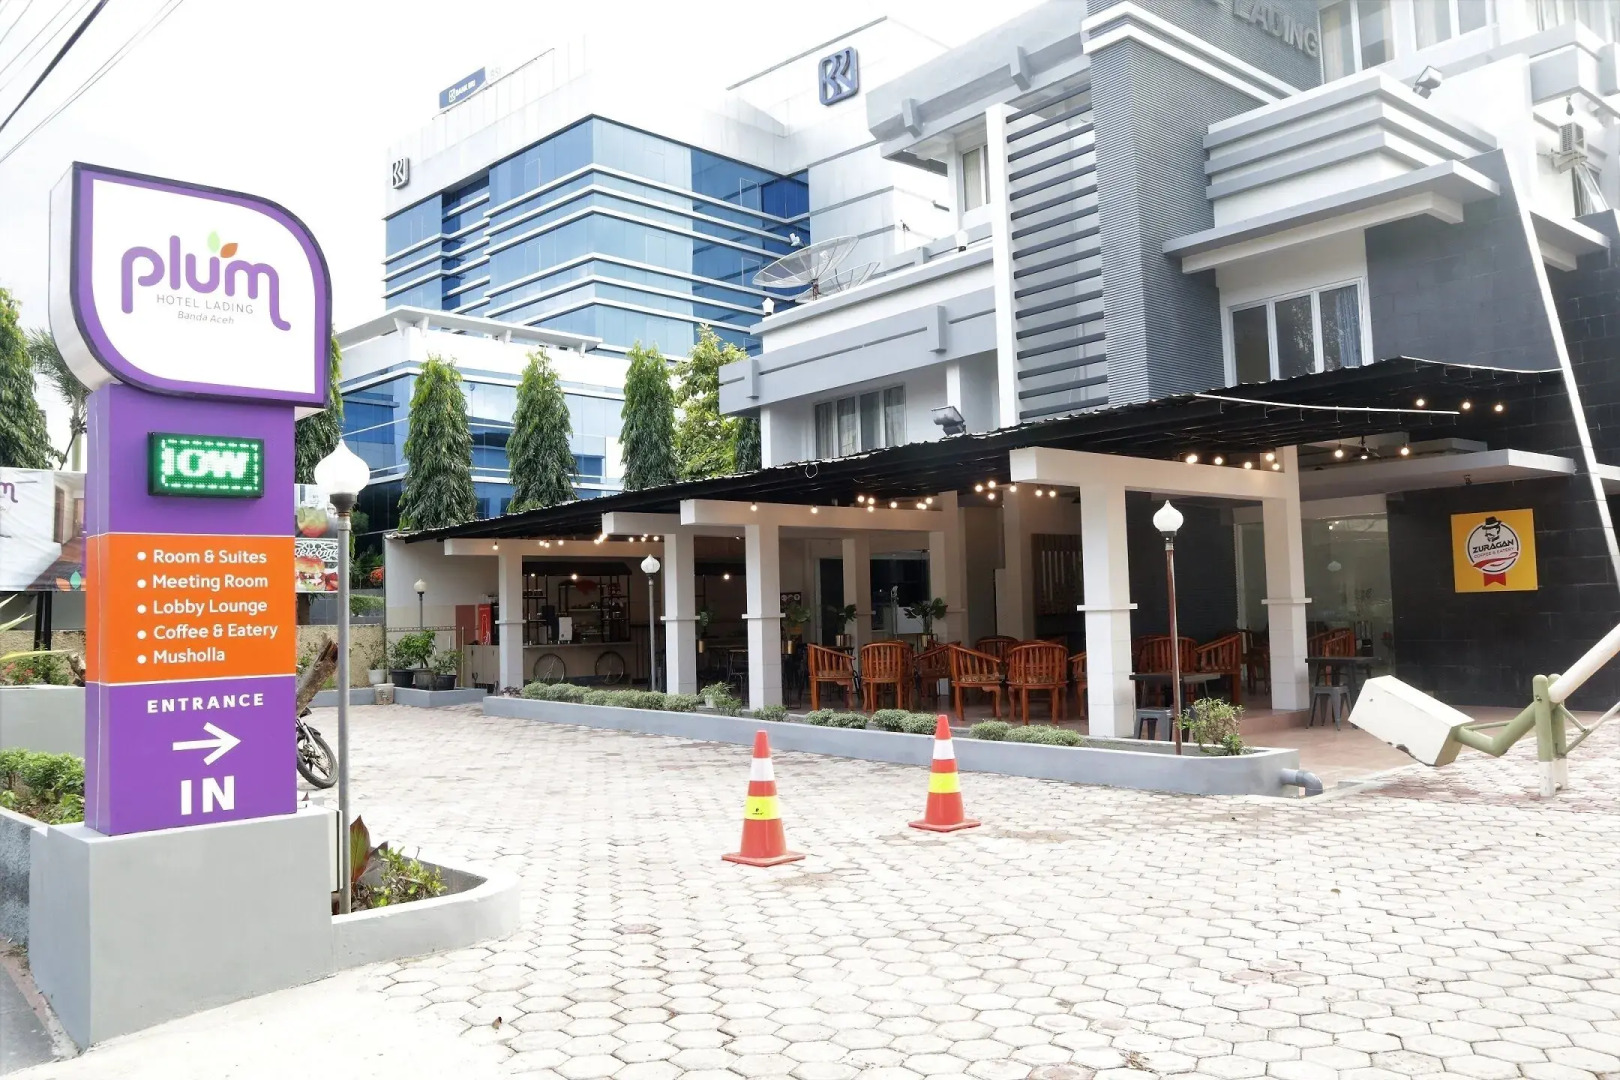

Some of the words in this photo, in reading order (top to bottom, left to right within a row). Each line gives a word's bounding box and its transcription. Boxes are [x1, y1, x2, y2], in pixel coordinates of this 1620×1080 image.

[1232, 0, 1319, 57] LADING
[121, 234, 291, 331] plum
[156, 293, 200, 308] HOTEL
[205, 299, 254, 314] LADING
[177, 310, 208, 322] Banda
[210, 314, 235, 325] Aceh
[1473, 539, 1514, 553] ZURAGAN
[153, 549, 200, 564] Room
[204, 549, 215, 563] &
[218, 550, 267, 564] Suites
[152, 574, 221, 592] Meeting
[224, 574, 268, 588] Room
[153, 598, 205, 617] Lobby
[209, 599, 268, 616] Lounge
[153, 624, 209, 639] Coffee
[213, 624, 223, 638] &
[228, 623, 278, 639] Eatery
[153, 647, 225, 664] Musholla
[147, 693, 264, 713] ENTRANCE
[181, 775, 235, 815] IN
